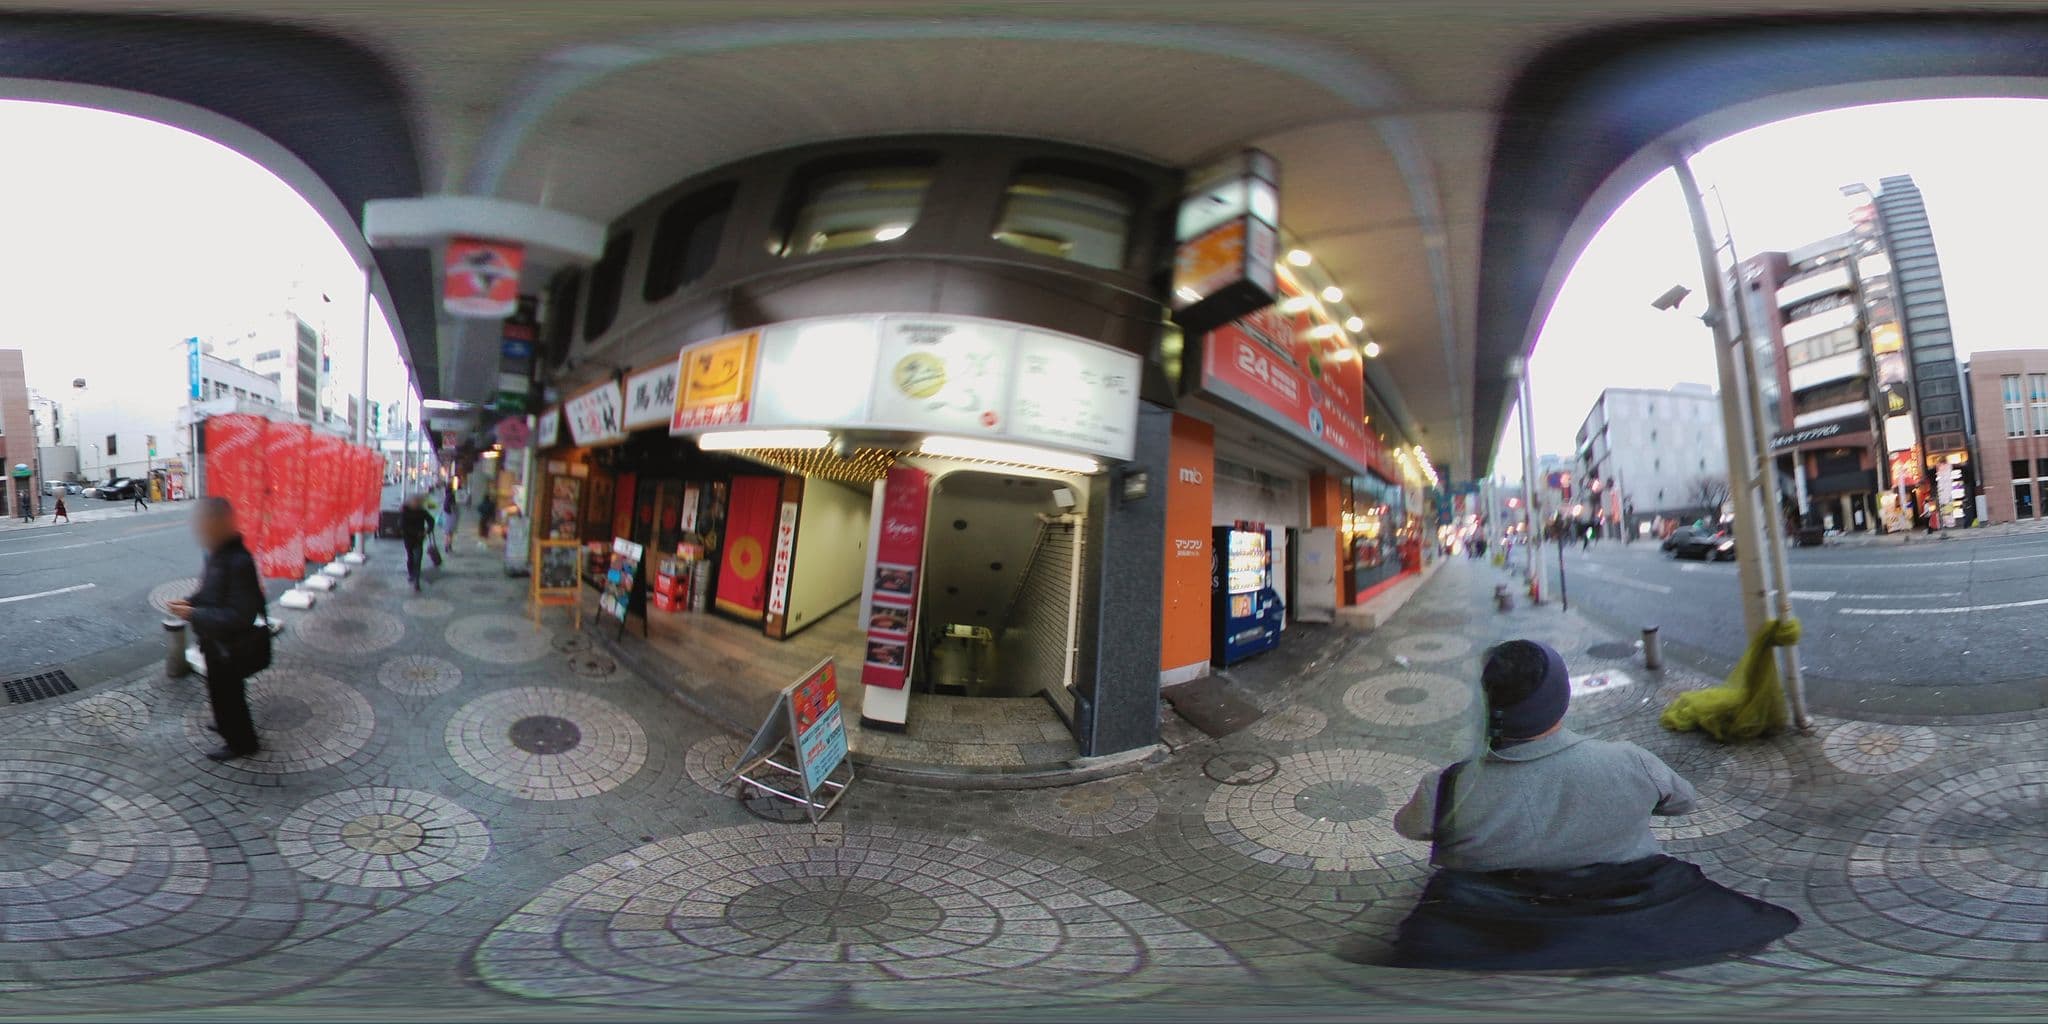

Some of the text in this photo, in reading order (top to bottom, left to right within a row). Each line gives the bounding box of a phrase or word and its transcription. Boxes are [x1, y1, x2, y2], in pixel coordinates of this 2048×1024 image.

[1237, 343, 1270, 384] 24
[772, 524, 793, 610] サッポロビール
